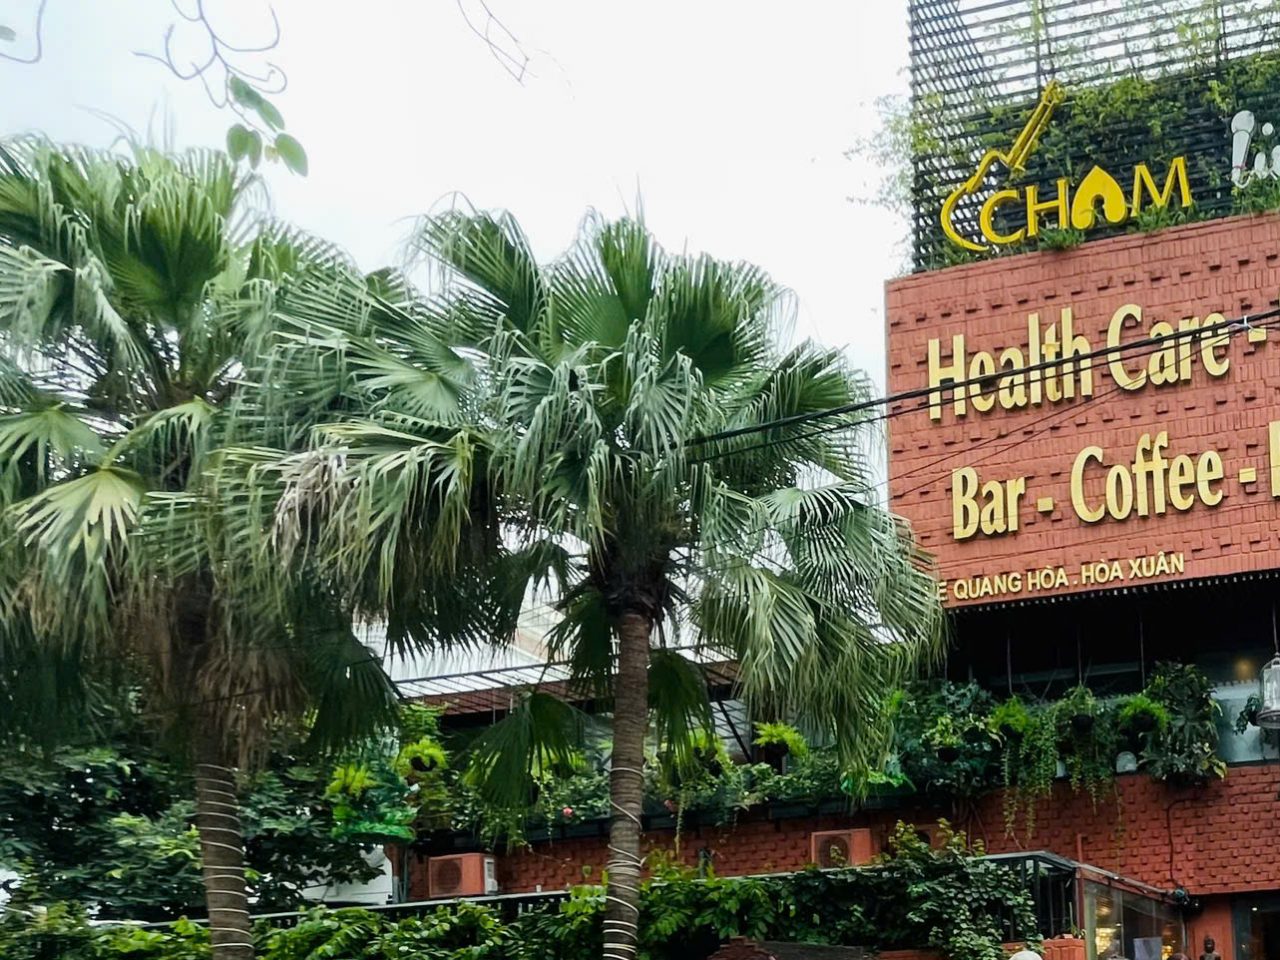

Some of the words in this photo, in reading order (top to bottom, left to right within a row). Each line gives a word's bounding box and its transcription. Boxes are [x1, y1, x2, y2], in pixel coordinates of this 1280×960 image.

[928, 307, 1094, 421] Health
[1107, 303, 1231, 391] Care
[952, 465, 1026, 540] Bar
[1070, 430, 1224, 523] Coffee
[954, 572, 1022, 600] QUANG
[1027, 564, 1069, 591] HÒA
[1081, 559, 1124, 585] HÒA
[1129, 551, 1185, 580] XUÂN
